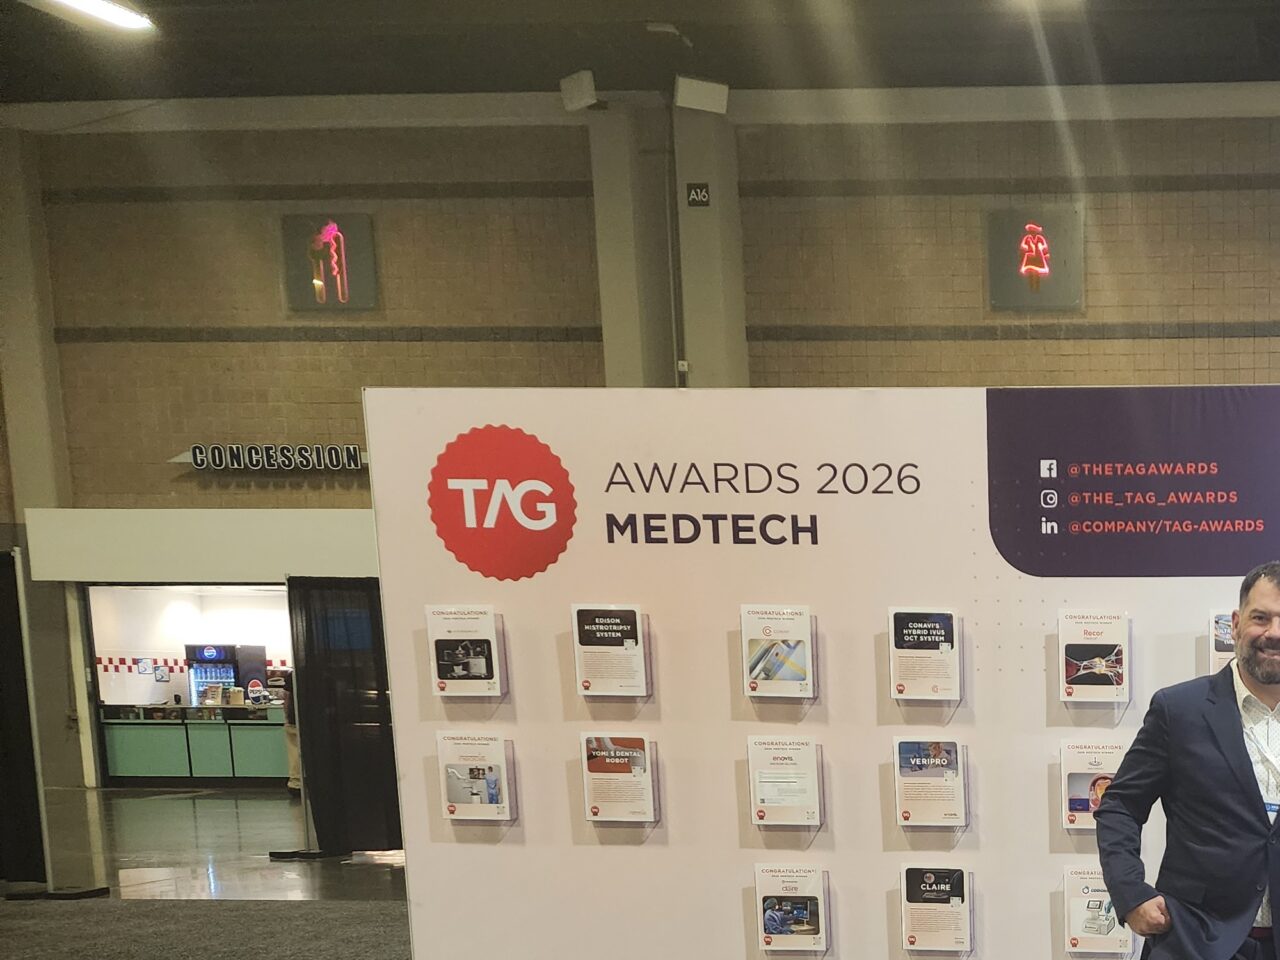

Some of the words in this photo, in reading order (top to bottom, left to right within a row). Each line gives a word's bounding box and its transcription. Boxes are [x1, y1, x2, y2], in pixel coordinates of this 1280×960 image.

[689, 188, 709, 202] A16
[1067, 462, 1219, 477] @THETAGAWARDS
[604, 461, 801, 495] AWARDS
[816, 461, 922, 495] 2026
[447, 477, 558, 531] TAG
[1067, 491, 1239, 507] @THE_TAG_AWARDS
[605, 513, 819, 545] MEDTECH
[1068, 519, 1265, 535] @COMPANY/TAG-AWARDS
[909, 757, 948, 765] VERIPRO
[920, 883, 951, 891] CLAIRE
